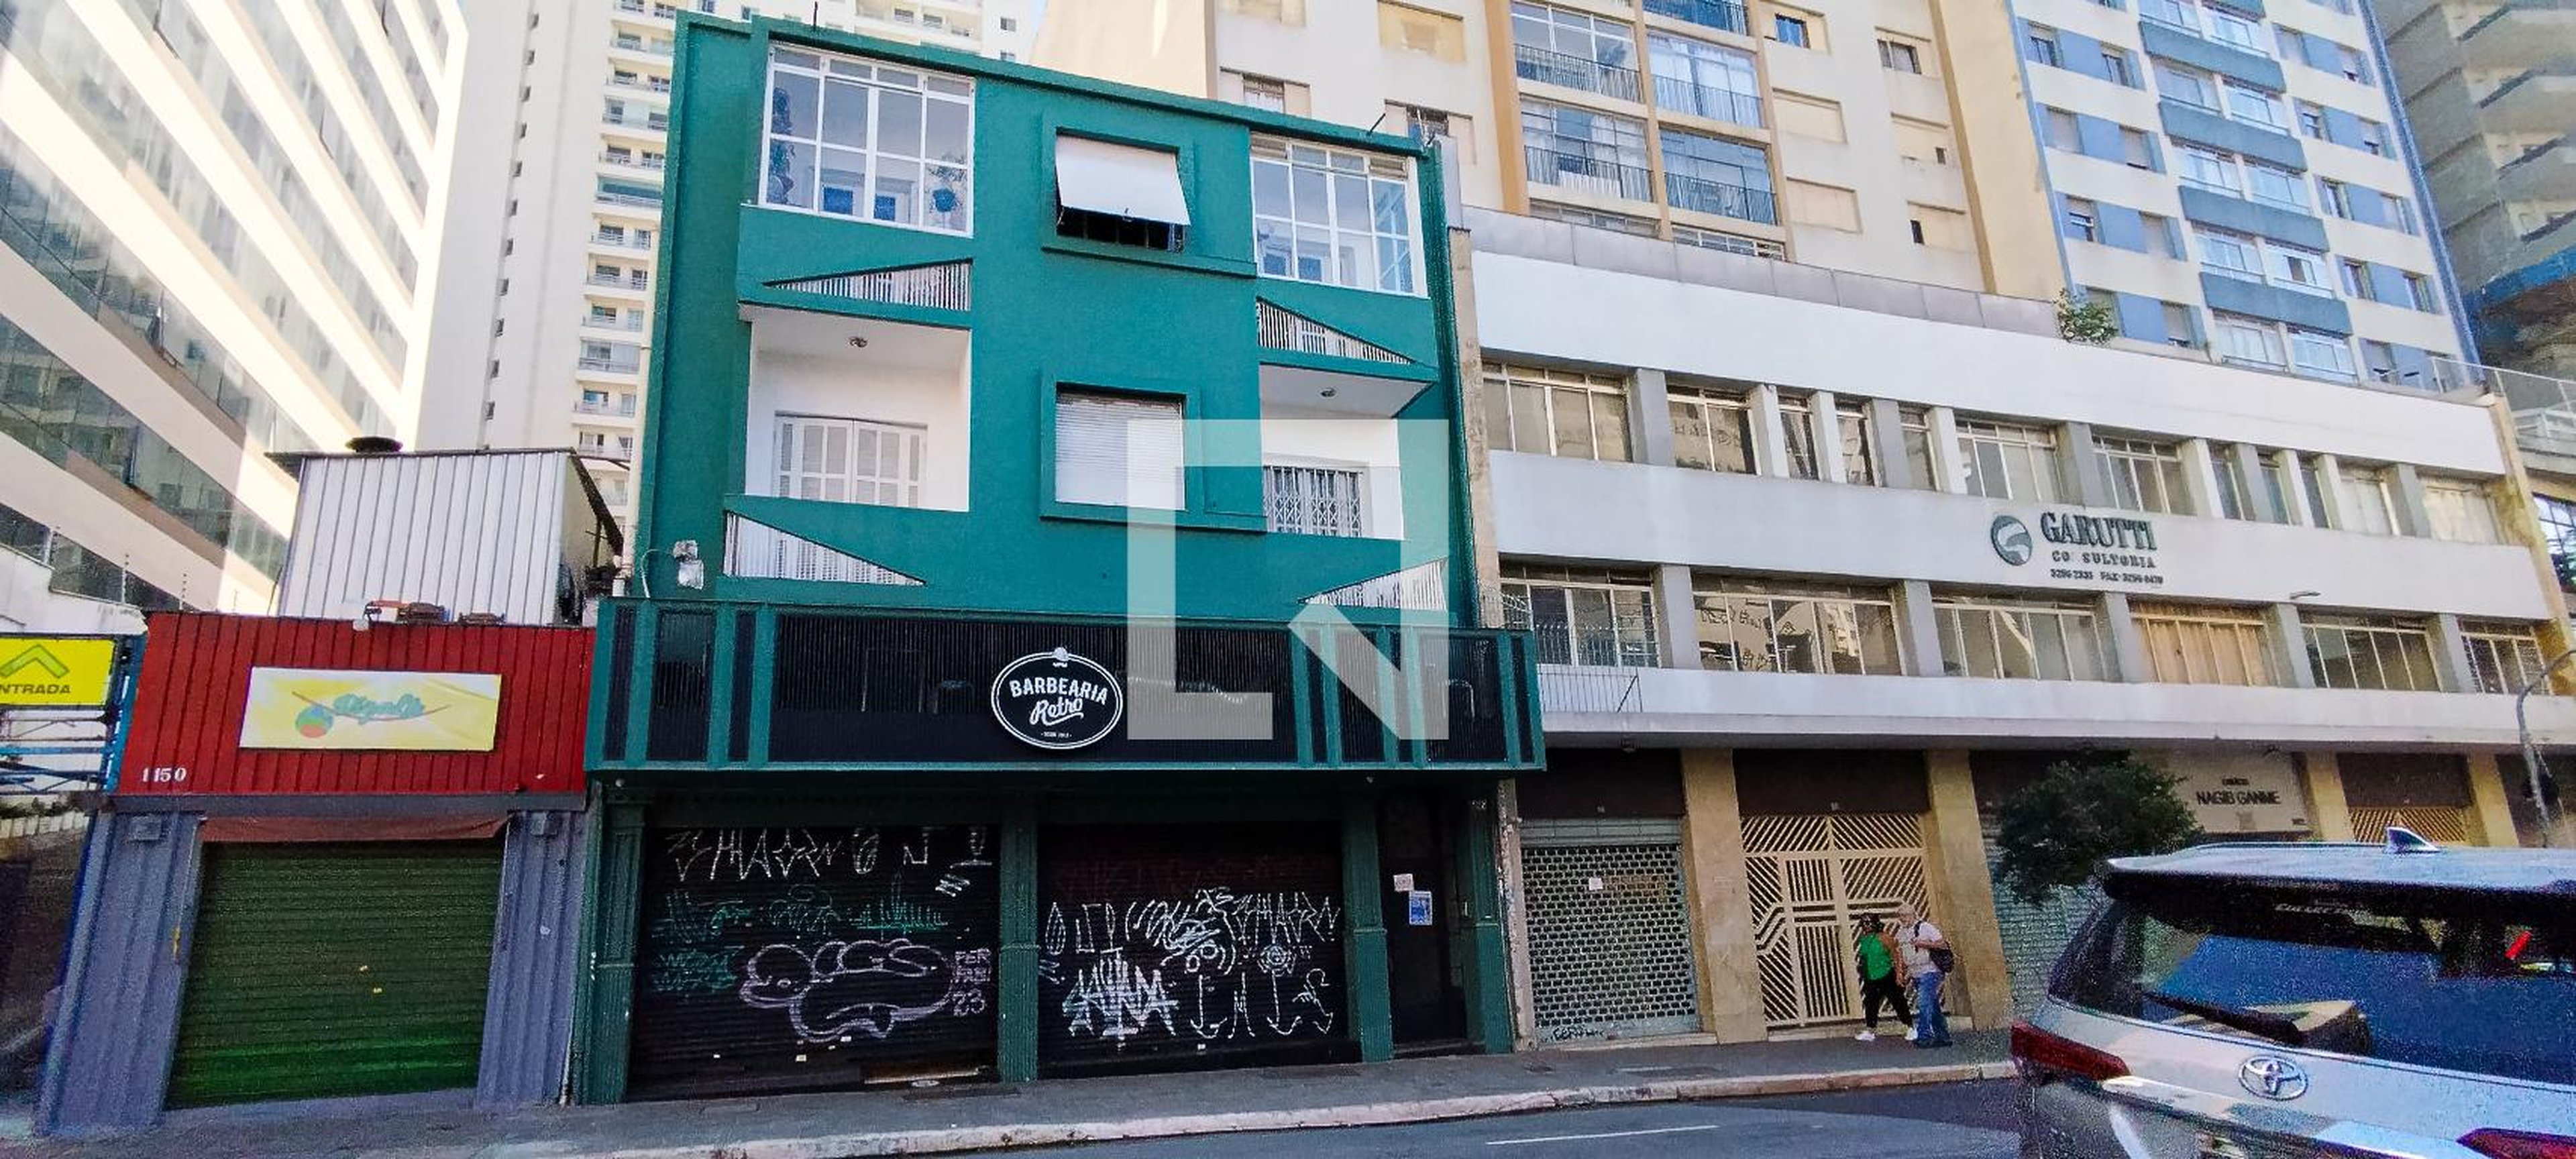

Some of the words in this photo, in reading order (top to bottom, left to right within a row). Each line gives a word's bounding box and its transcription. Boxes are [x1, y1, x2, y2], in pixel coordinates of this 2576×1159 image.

[2040, 511, 2157, 551] GARUTTI
[1008, 676, 1108, 706] BARBEARIA
[1028, 696, 1085, 726] Retro
[142, 767, 187, 783] 1150
